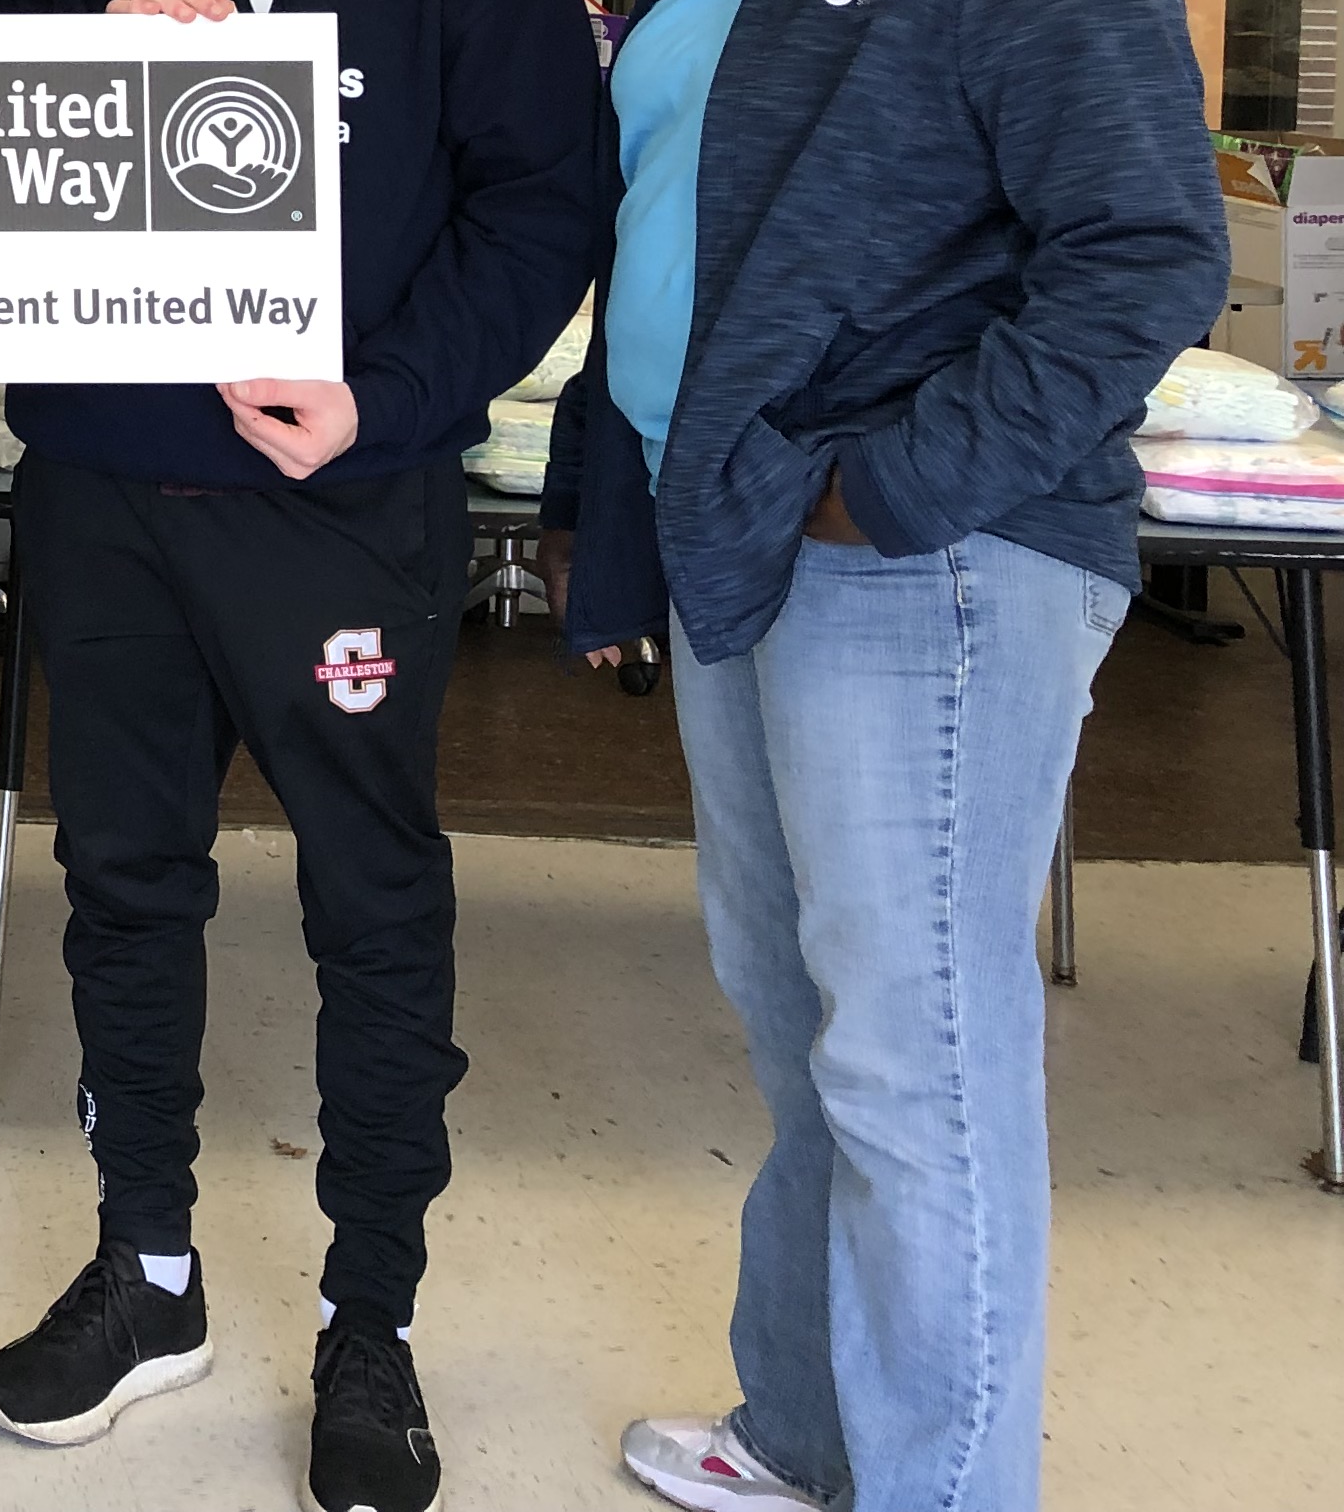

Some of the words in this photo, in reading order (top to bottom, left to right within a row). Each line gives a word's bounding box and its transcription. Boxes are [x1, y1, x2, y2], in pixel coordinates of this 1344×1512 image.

[1, 148, 133, 222] Way
[73, 286, 212, 325] United
[225, 288, 318, 335] Way
[317, 661, 394, 680] CHARLESTON
